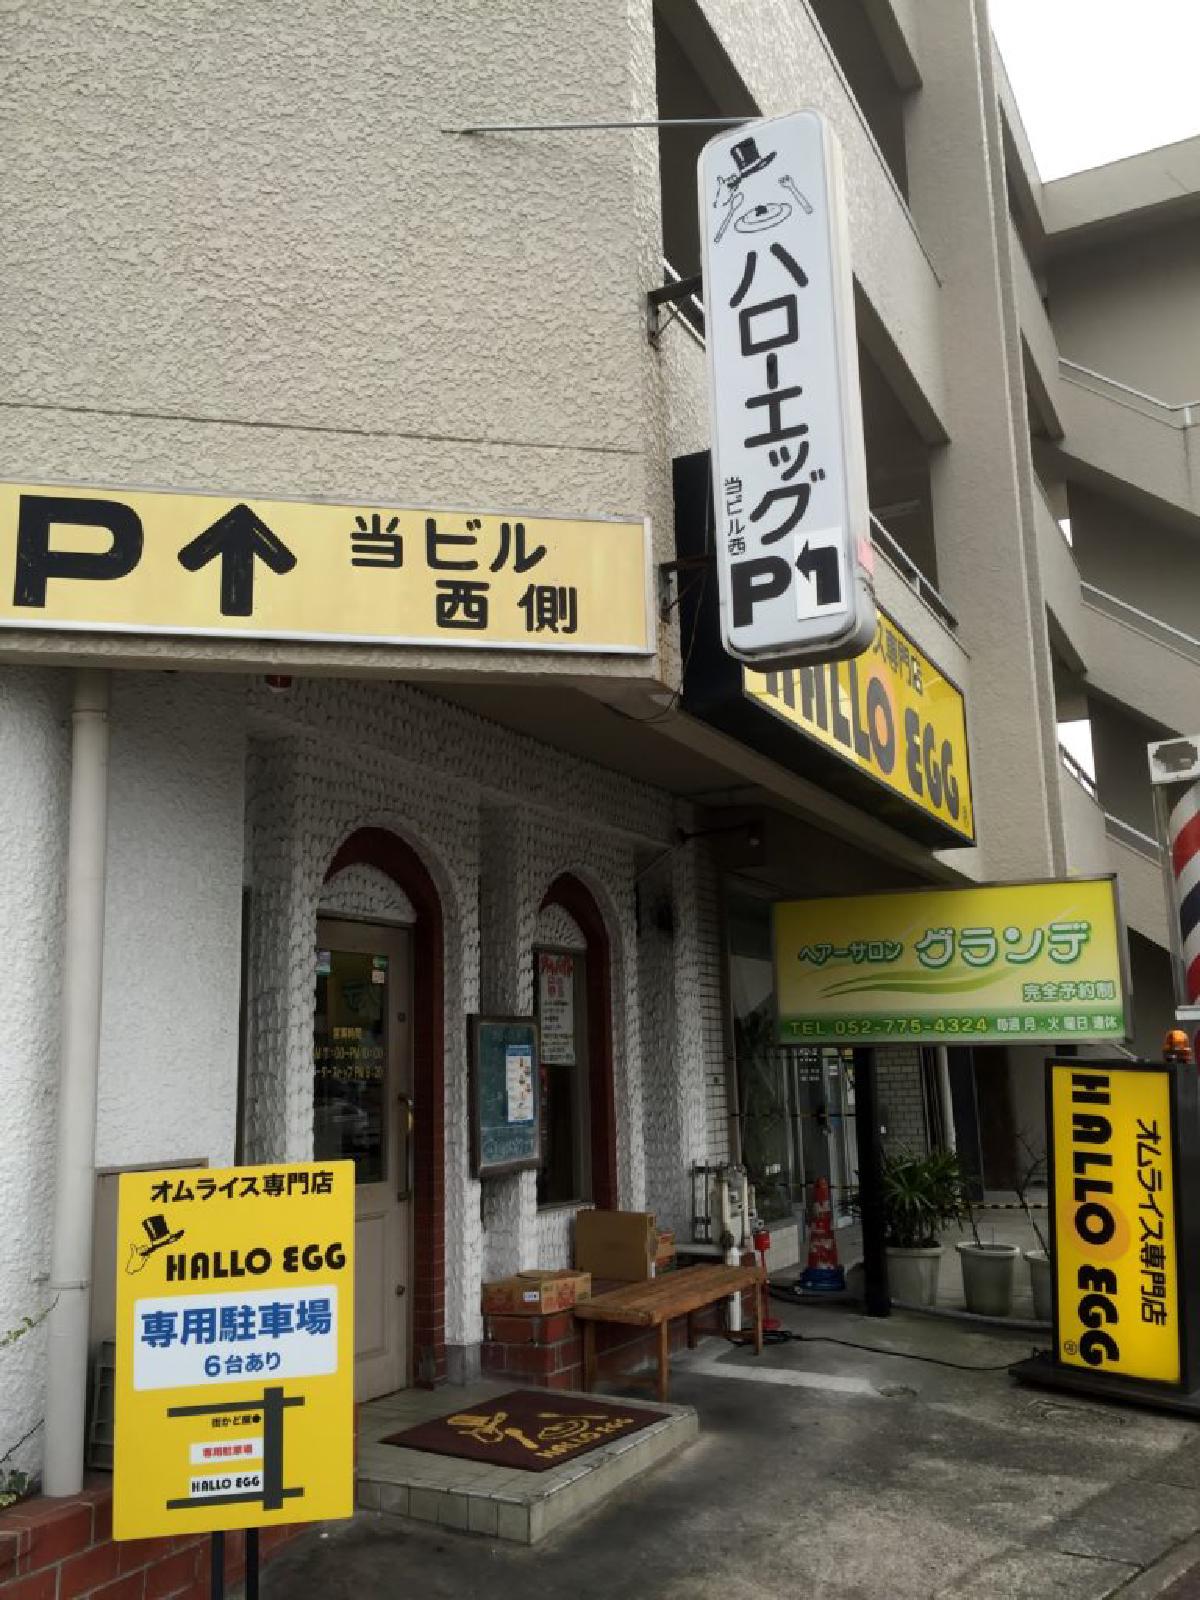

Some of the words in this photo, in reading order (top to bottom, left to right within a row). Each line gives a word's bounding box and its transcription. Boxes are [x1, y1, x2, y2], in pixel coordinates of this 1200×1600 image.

[729, 242, 826, 545] ハローエッグ
[13, 495, 144, 608] P
[351, 513, 547, 575] 当ビル
[435, 579, 578, 634] 西側
[731, 556, 792, 628] P
[904, 707, 960, 821] EGG
[798, 941, 903, 965] ヘアーサロン
[914, 921, 1090, 968] グランデ
[790, 1021, 825, 1035] TEL
[834, 1017, 989, 1035] 052-775-4324
[151, 1170, 334, 1203] オムライス専門店
[1071, 1072, 1116, 1246] HALLO
[1136, 1118, 1168, 1327] オムライス専門店
[166, 1247, 272, 1281] HALLO
[282, 1242, 347, 1273] EGG
[141, 1298, 332, 1348] 専用駐車場
[1077, 1263, 1120, 1367] EGG
[204, 1351, 281, 1378] 6台あり
[191, 1478, 232, 1493] HALLO
[235, 1475, 260, 1489] EGG
